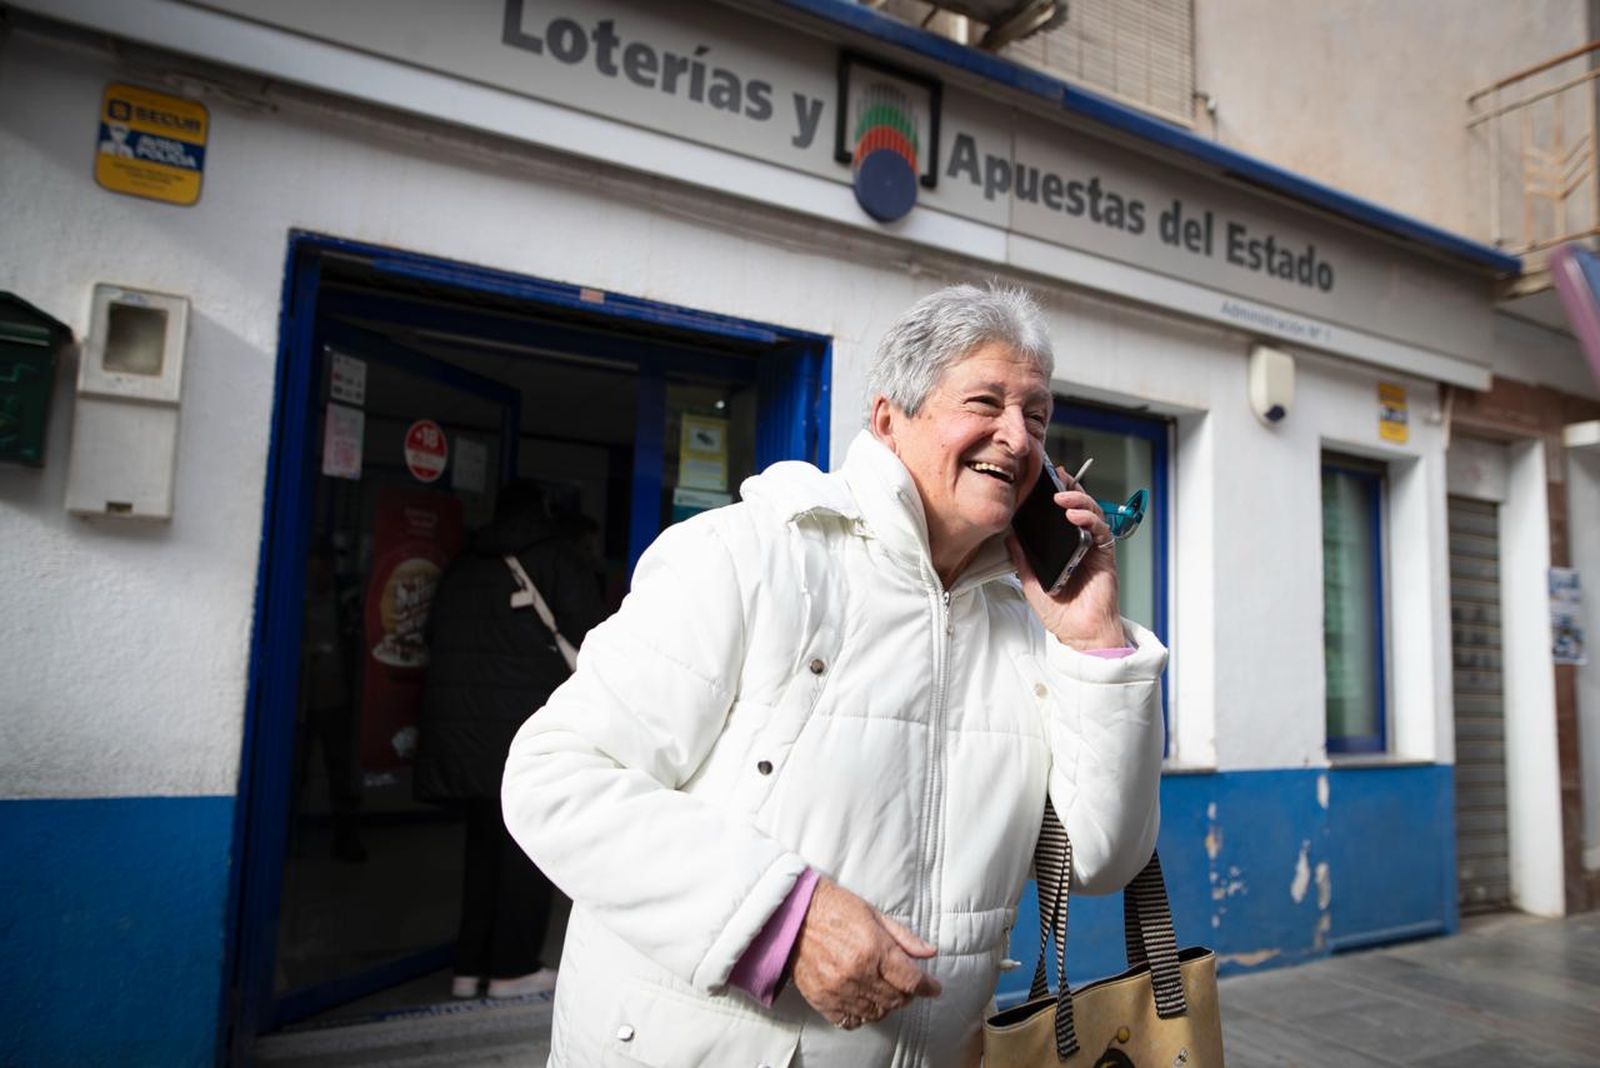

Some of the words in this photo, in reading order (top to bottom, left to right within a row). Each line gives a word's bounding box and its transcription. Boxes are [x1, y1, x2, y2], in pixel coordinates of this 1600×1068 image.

[501, 0, 774, 122] Loterías
[791, 91, 824, 149] y
[946, 132, 1146, 235] Apuestas
[1159, 199, 1214, 257] del
[1225, 221, 1335, 292] Estado
